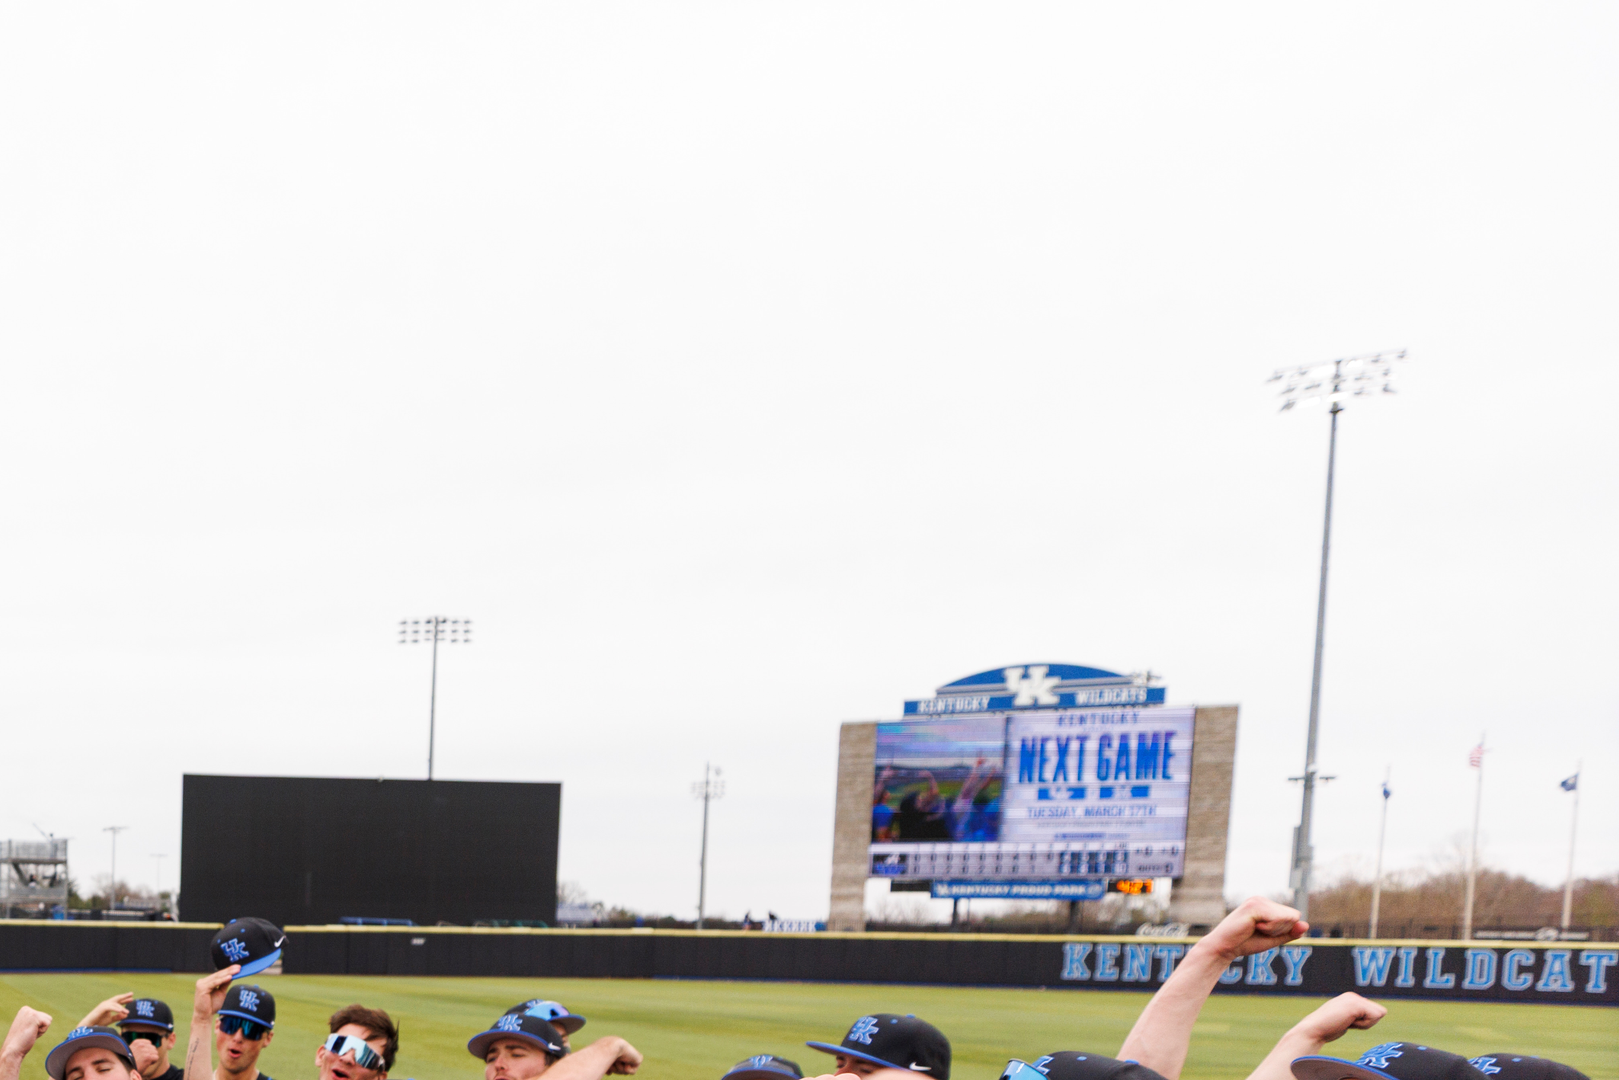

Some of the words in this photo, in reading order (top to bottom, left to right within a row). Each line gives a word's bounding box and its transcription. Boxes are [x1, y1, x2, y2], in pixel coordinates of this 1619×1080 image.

[918, 696, 991, 714] KENTUCKY
[1075, 687, 1148, 705] WILDCATS
[1004, 666, 1061, 706] UK
[1018, 733, 1090, 785] NEXT
[1097, 730, 1177, 781] GAME
[952, 884, 1011, 895] KENTUCKY
[1011, 884, 1052, 895] PROUD
[1061, 943, 1313, 986] KENTCKY
[1352, 946, 1619, 994] WILDCAT
